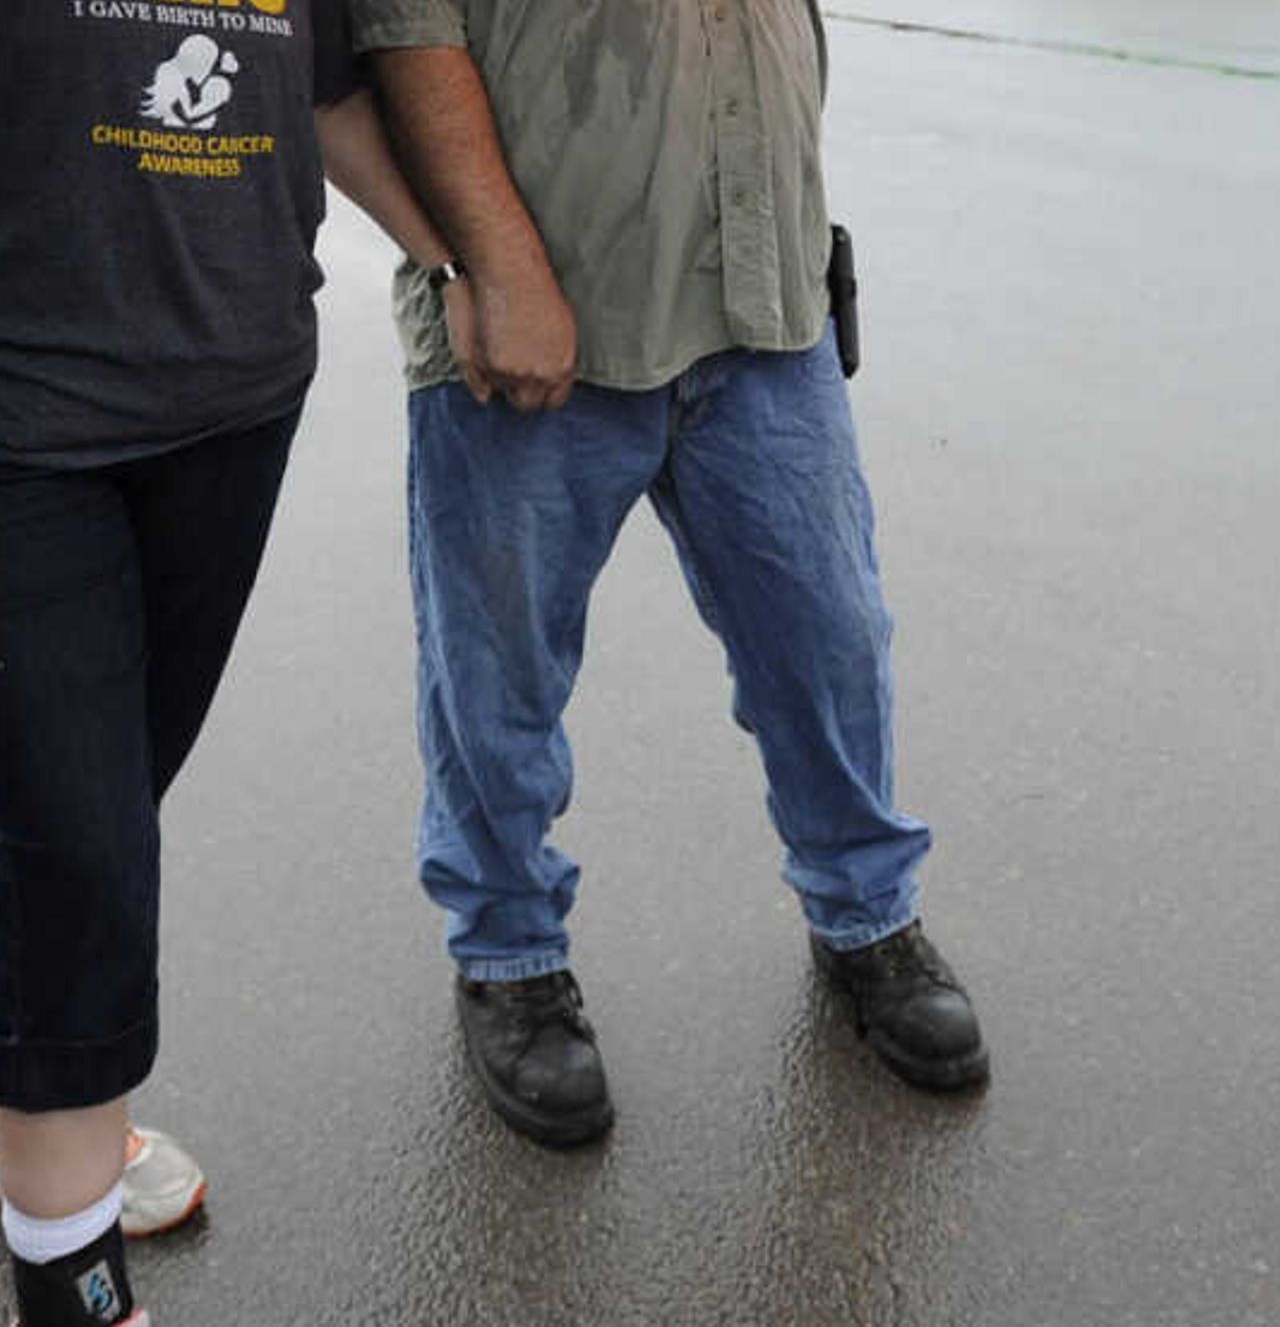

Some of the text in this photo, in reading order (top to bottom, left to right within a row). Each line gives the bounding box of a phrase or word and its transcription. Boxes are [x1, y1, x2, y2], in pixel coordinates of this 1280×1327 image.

[73, 0, 83, 17] I
[89, 0, 152, 21] GAVE
[156, 5, 215, 28] BIRTH
[219, 11, 246, 30] TO
[91, 124, 275, 155] CHILDHOOD CANCER
[137, 152, 241, 177] AWARENESS
